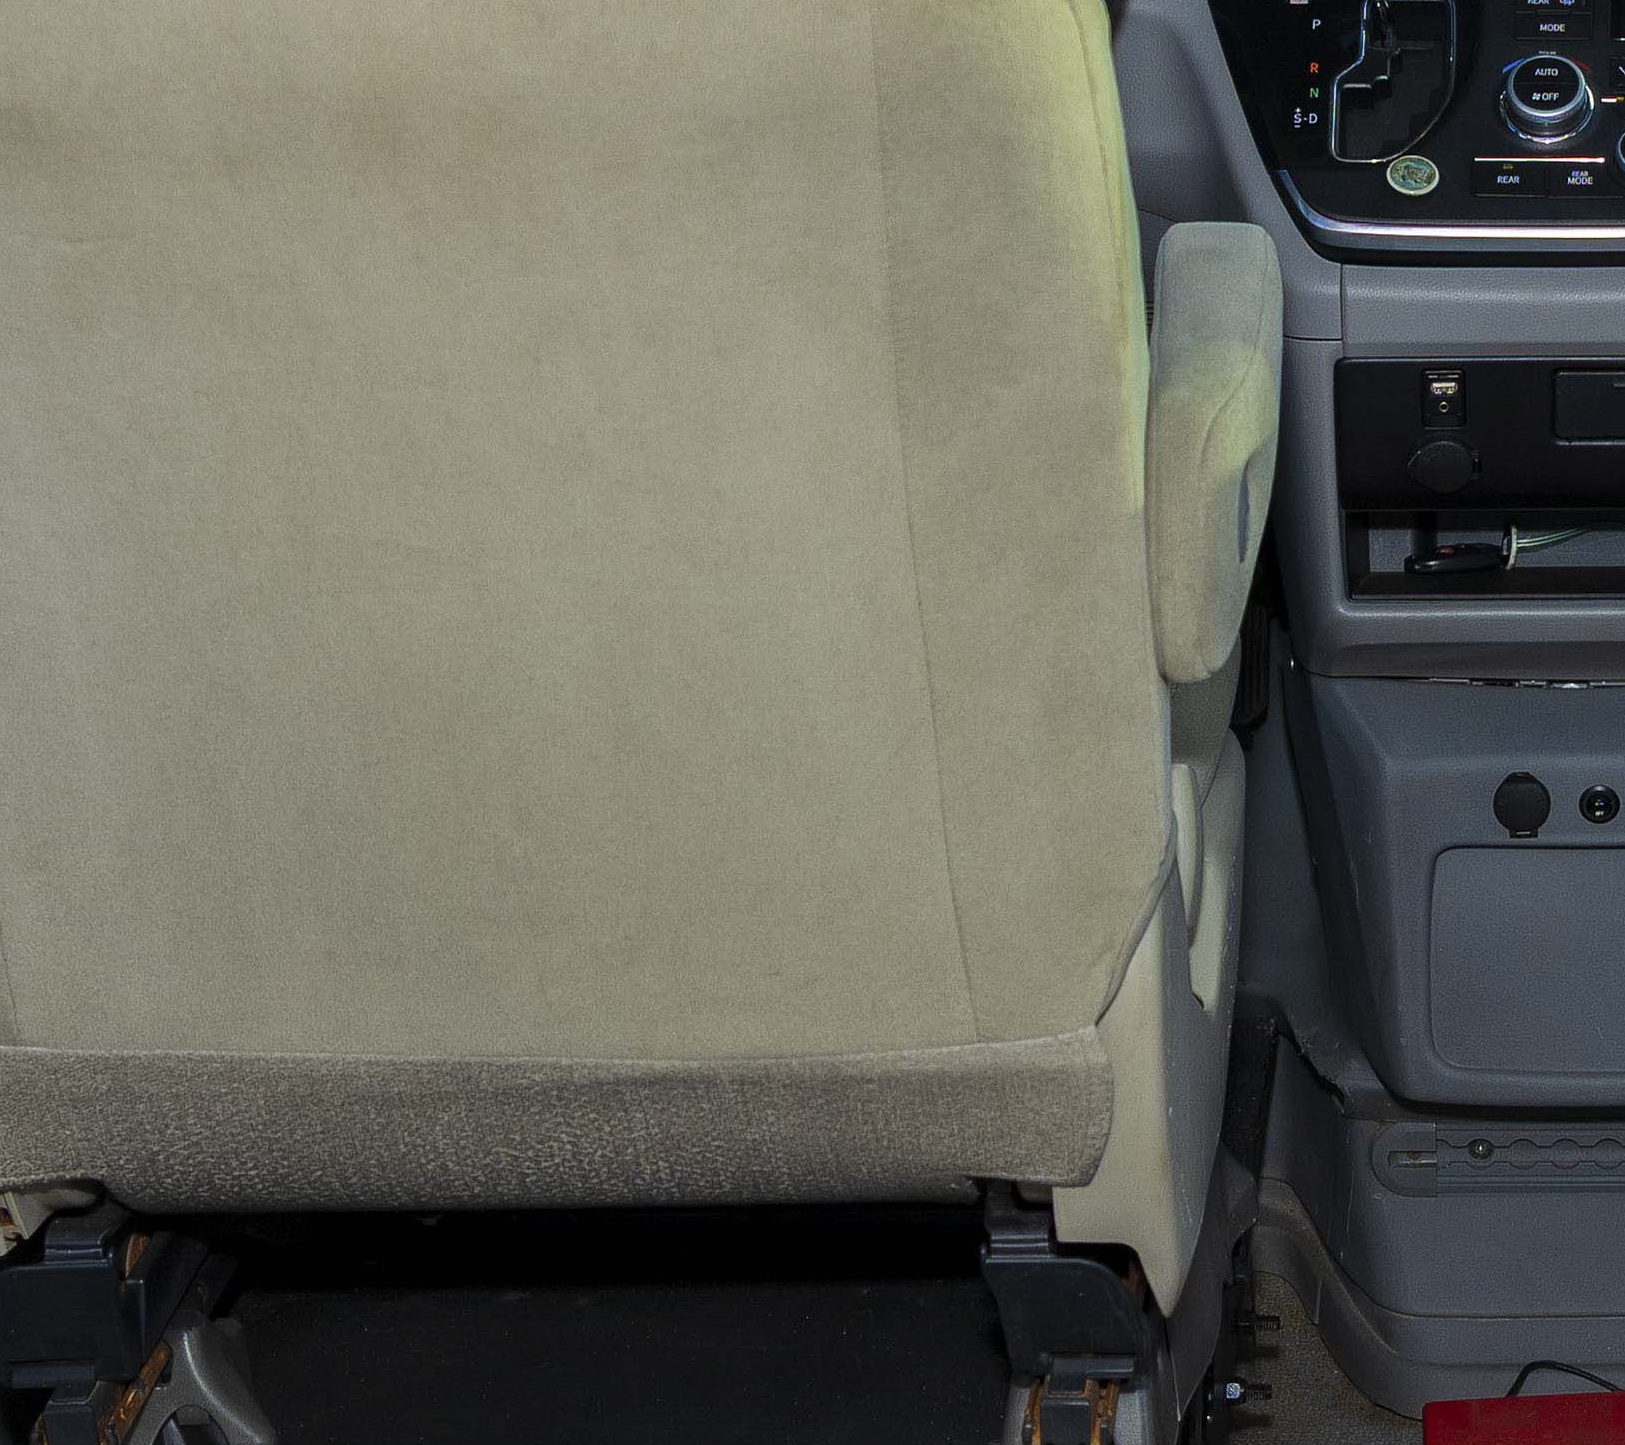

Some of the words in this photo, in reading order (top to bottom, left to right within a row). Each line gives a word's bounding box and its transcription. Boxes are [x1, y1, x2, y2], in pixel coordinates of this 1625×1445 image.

[1311, 18, 1322, 30] P
[1539, 22, 1566, 33] MODE
[1309, 62, 1319, 74] R
[1534, 66, 1559, 77] AUTO
[1309, 87, 1320, 99] N
[1541, 91, 1560, 102] OFF
[1496, 174, 1521, 185] REAR
[1567, 175, 1594, 186] MODE
